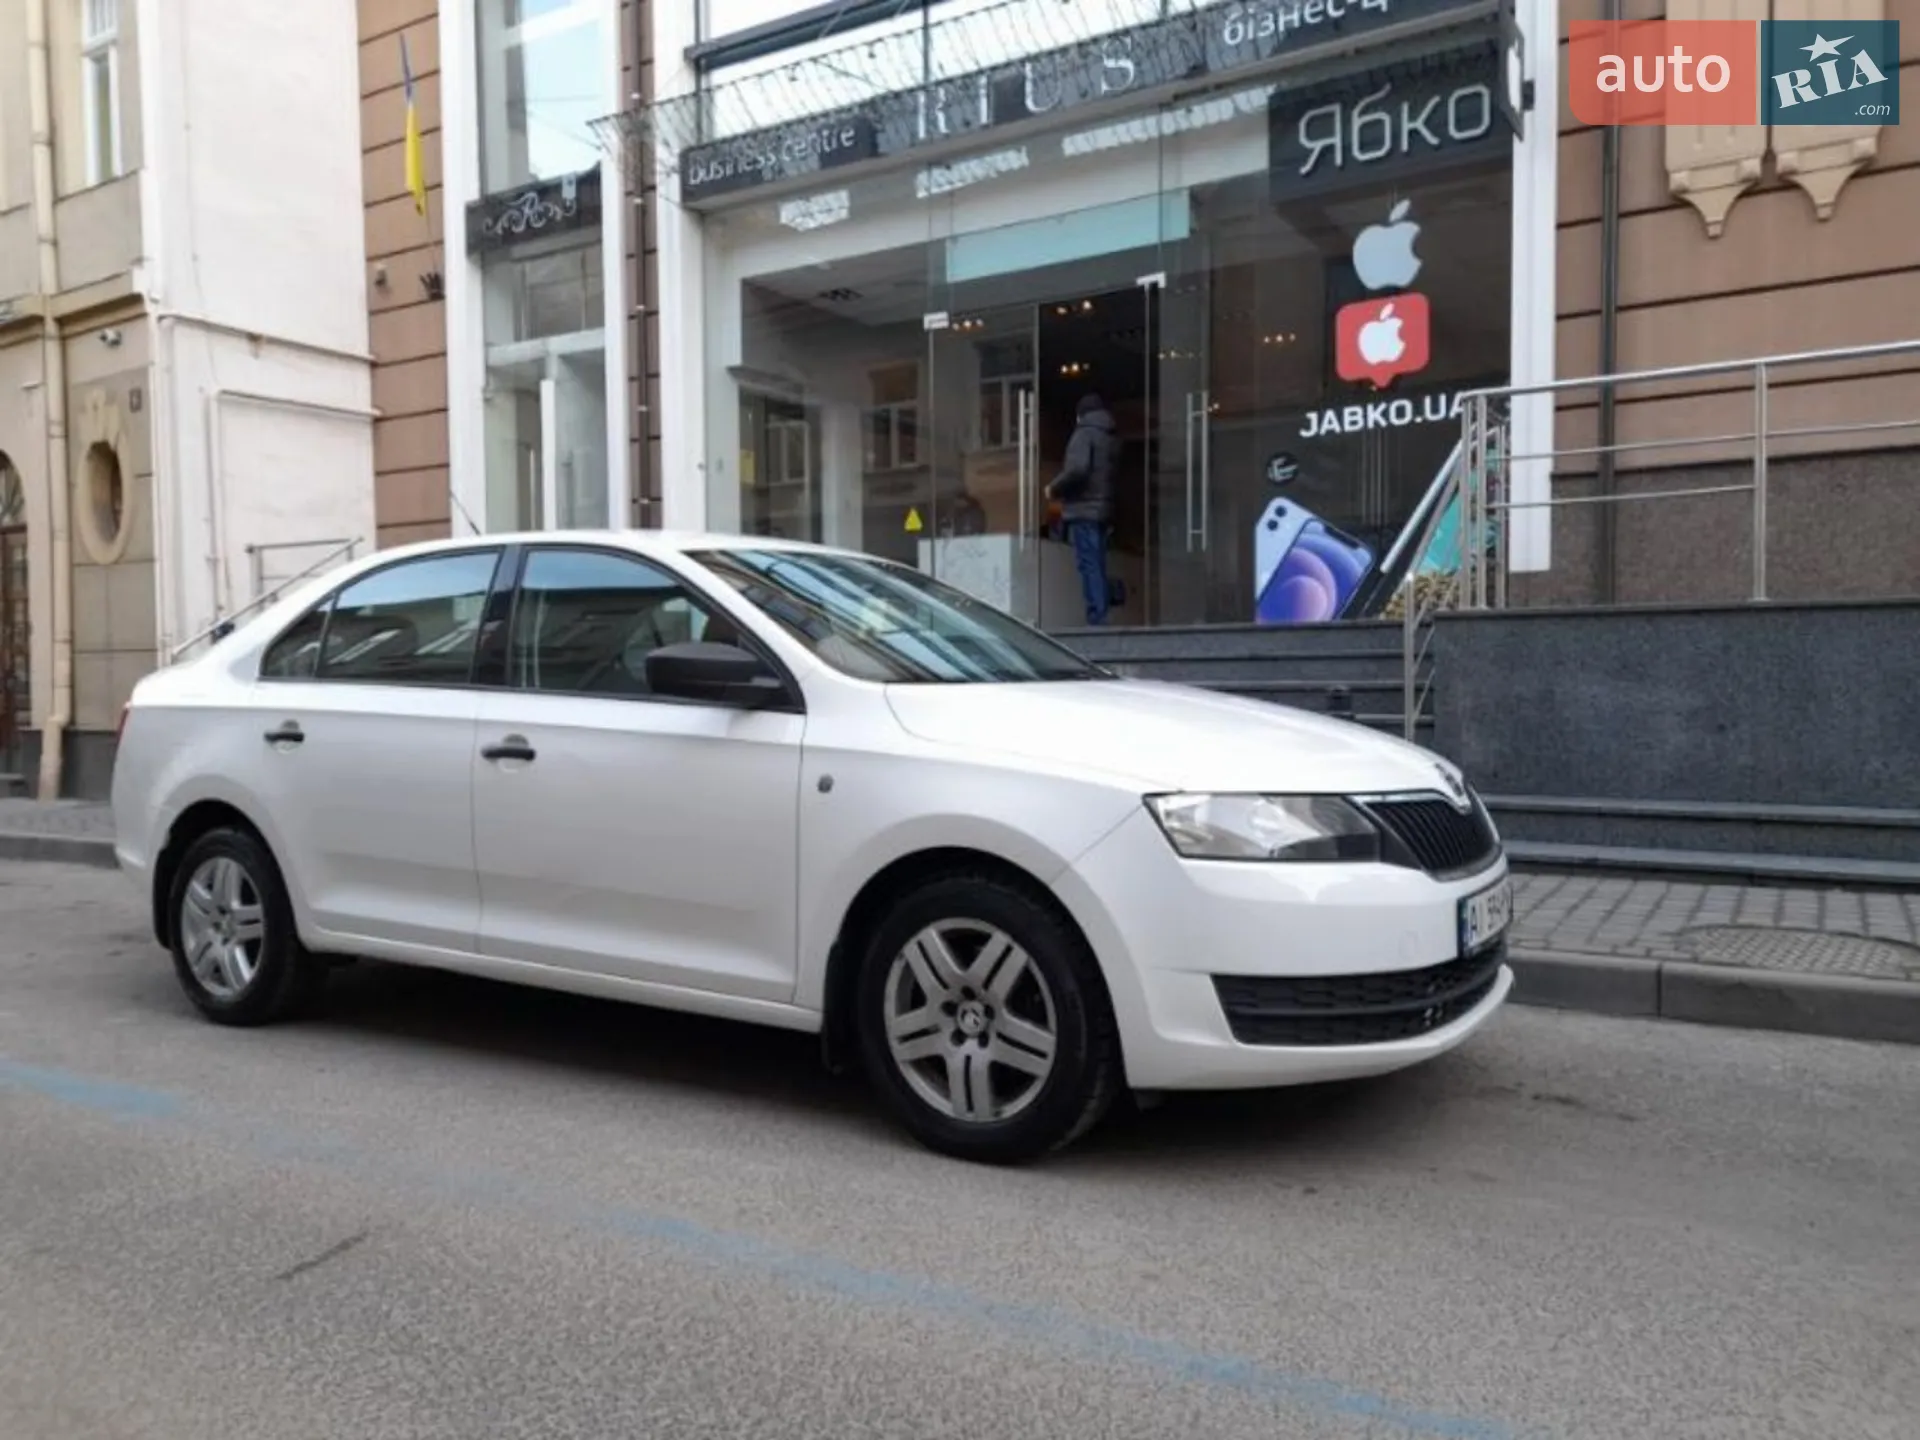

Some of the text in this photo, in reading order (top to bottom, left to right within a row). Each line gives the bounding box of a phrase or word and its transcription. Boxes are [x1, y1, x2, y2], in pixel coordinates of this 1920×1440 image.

[687, 124, 856, 187] business centre
[1299, 83, 1491, 177] Ябко
